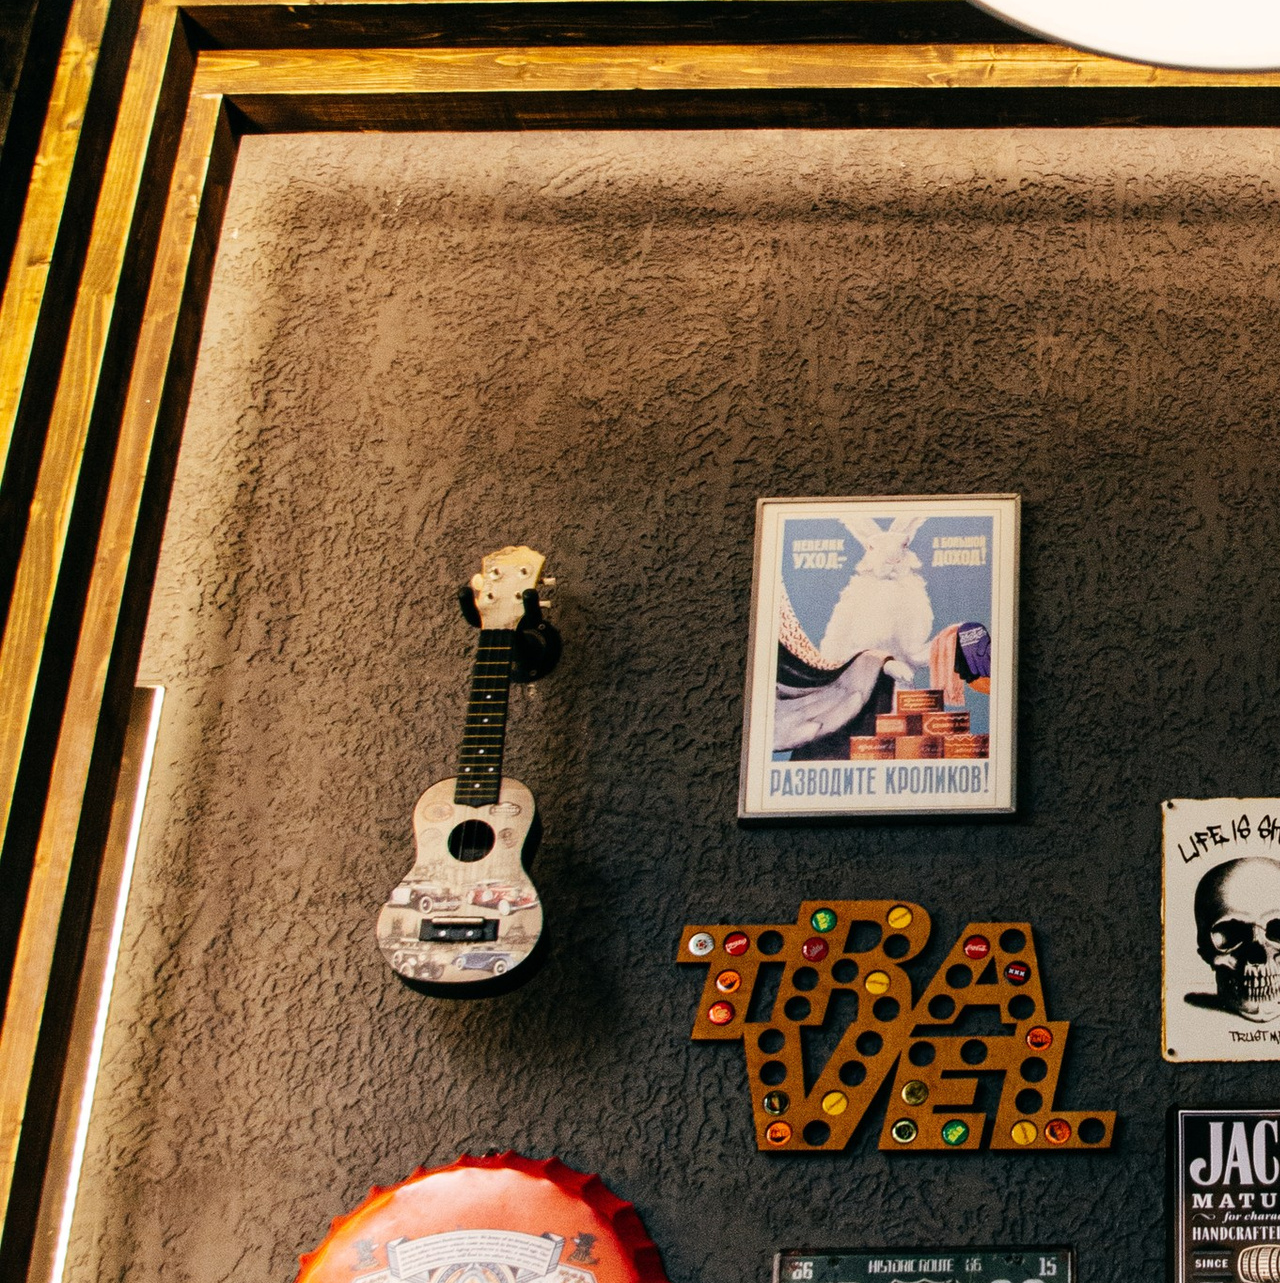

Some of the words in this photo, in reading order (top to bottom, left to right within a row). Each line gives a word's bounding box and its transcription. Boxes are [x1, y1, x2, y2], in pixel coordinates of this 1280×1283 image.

[769, 766, 876, 797] РАЗВОДИТЕ
[885, 761, 990, 795] КРОЛИКОВ!
[1178, 824, 1230, 864] LIFE
[1232, 814, 1252, 841] IS
[1228, 1029, 1269, 1043] TRUST
[1222, 1211, 1242, 1223] for
[867, 1259, 917, 1274] HISTORIC
[918, 1258, 955, 1273] ROUTE
[1195, 1258, 1229, 1269] SINCE
